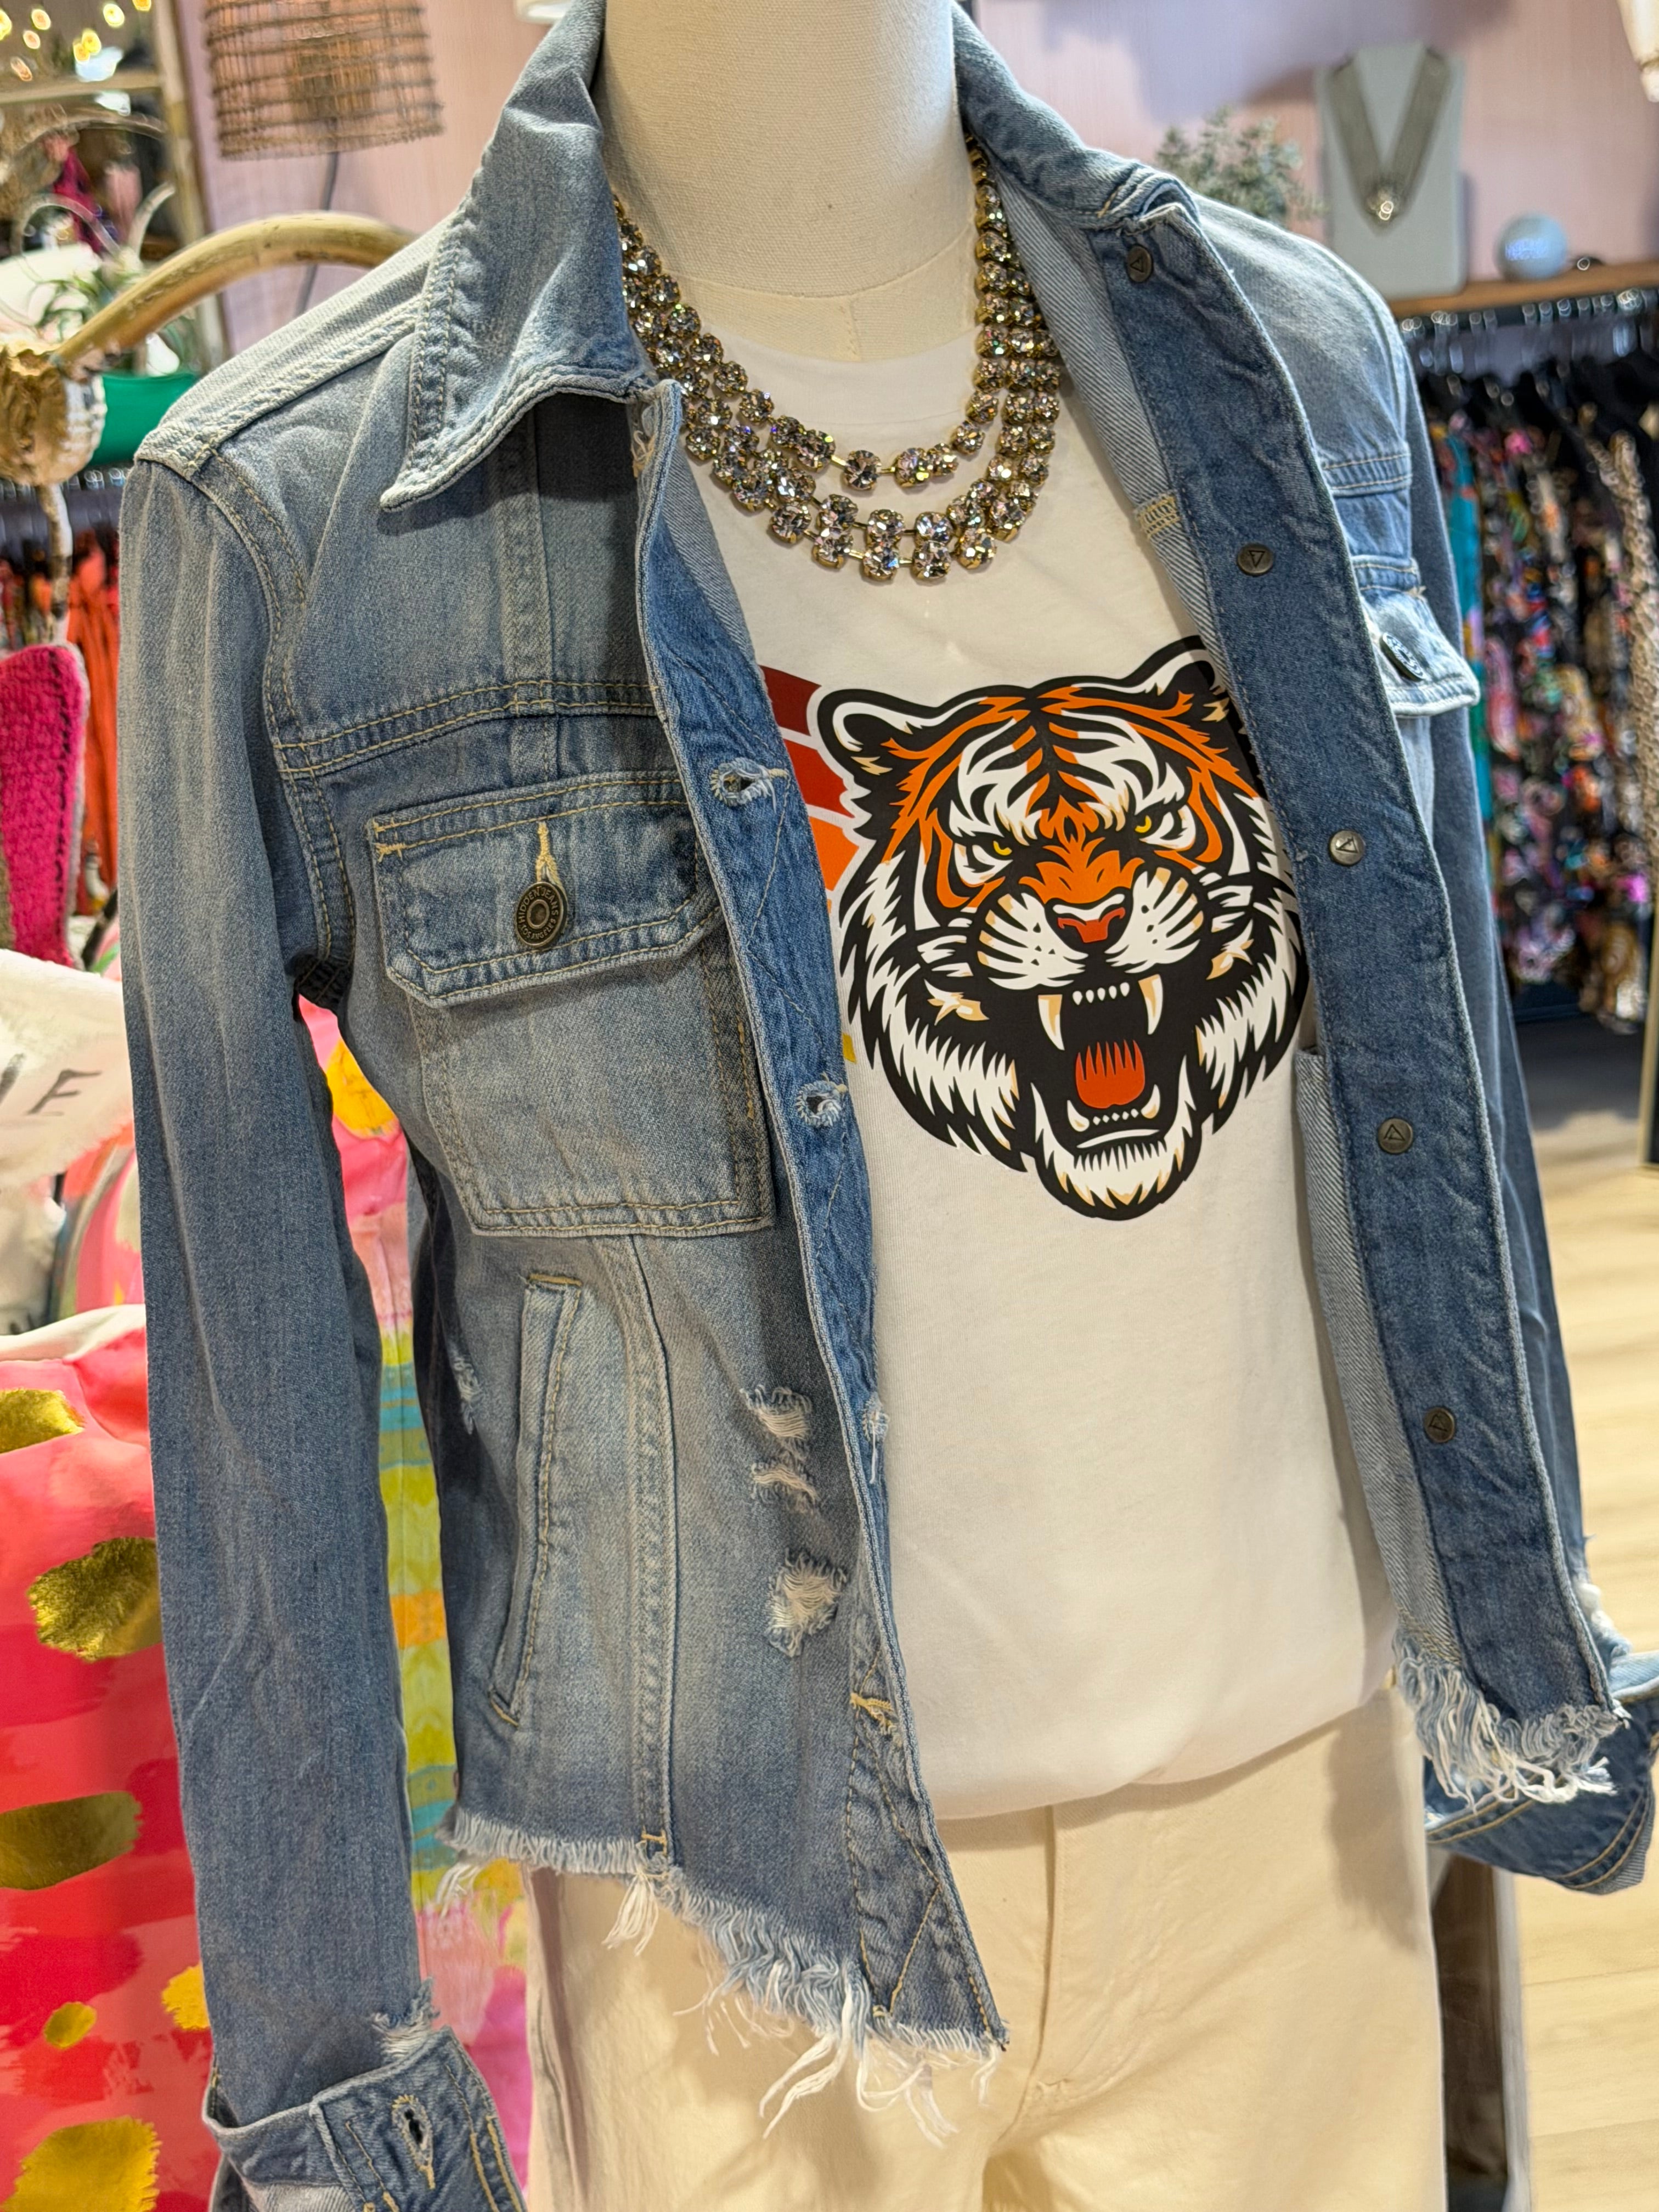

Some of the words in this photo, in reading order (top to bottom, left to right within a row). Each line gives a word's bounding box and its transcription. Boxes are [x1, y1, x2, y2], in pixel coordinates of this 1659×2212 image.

[518, 886, 542, 923] HIDDEN
[541, 888, 558, 915] JEANS
[521, 925, 532, 938] LOS
[531, 918, 556, 940] ANGELES
